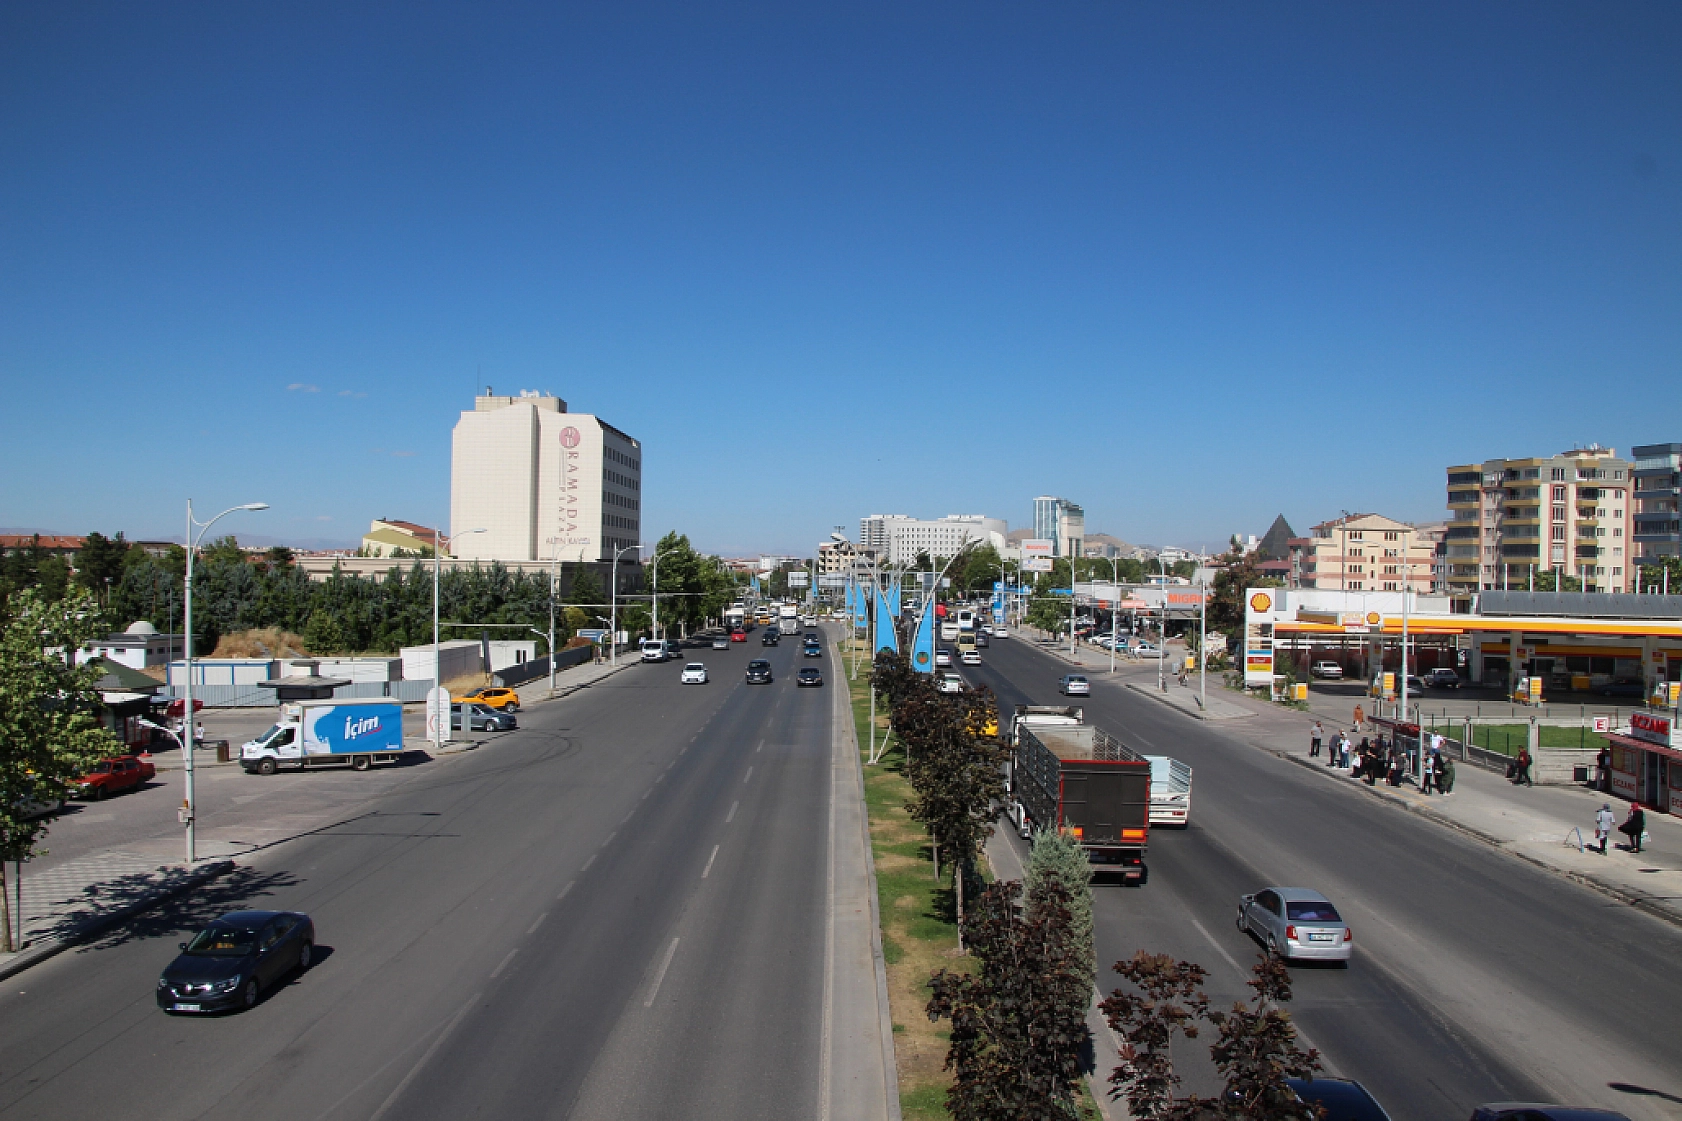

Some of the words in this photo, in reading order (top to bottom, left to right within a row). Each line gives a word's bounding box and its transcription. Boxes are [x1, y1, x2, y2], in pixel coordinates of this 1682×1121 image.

[567, 451, 579, 531] RAMADA
[344, 715, 379, 740] İçim
[1596, 720, 1606, 730] E
[1632, 713, 1670, 735] ECZANE
